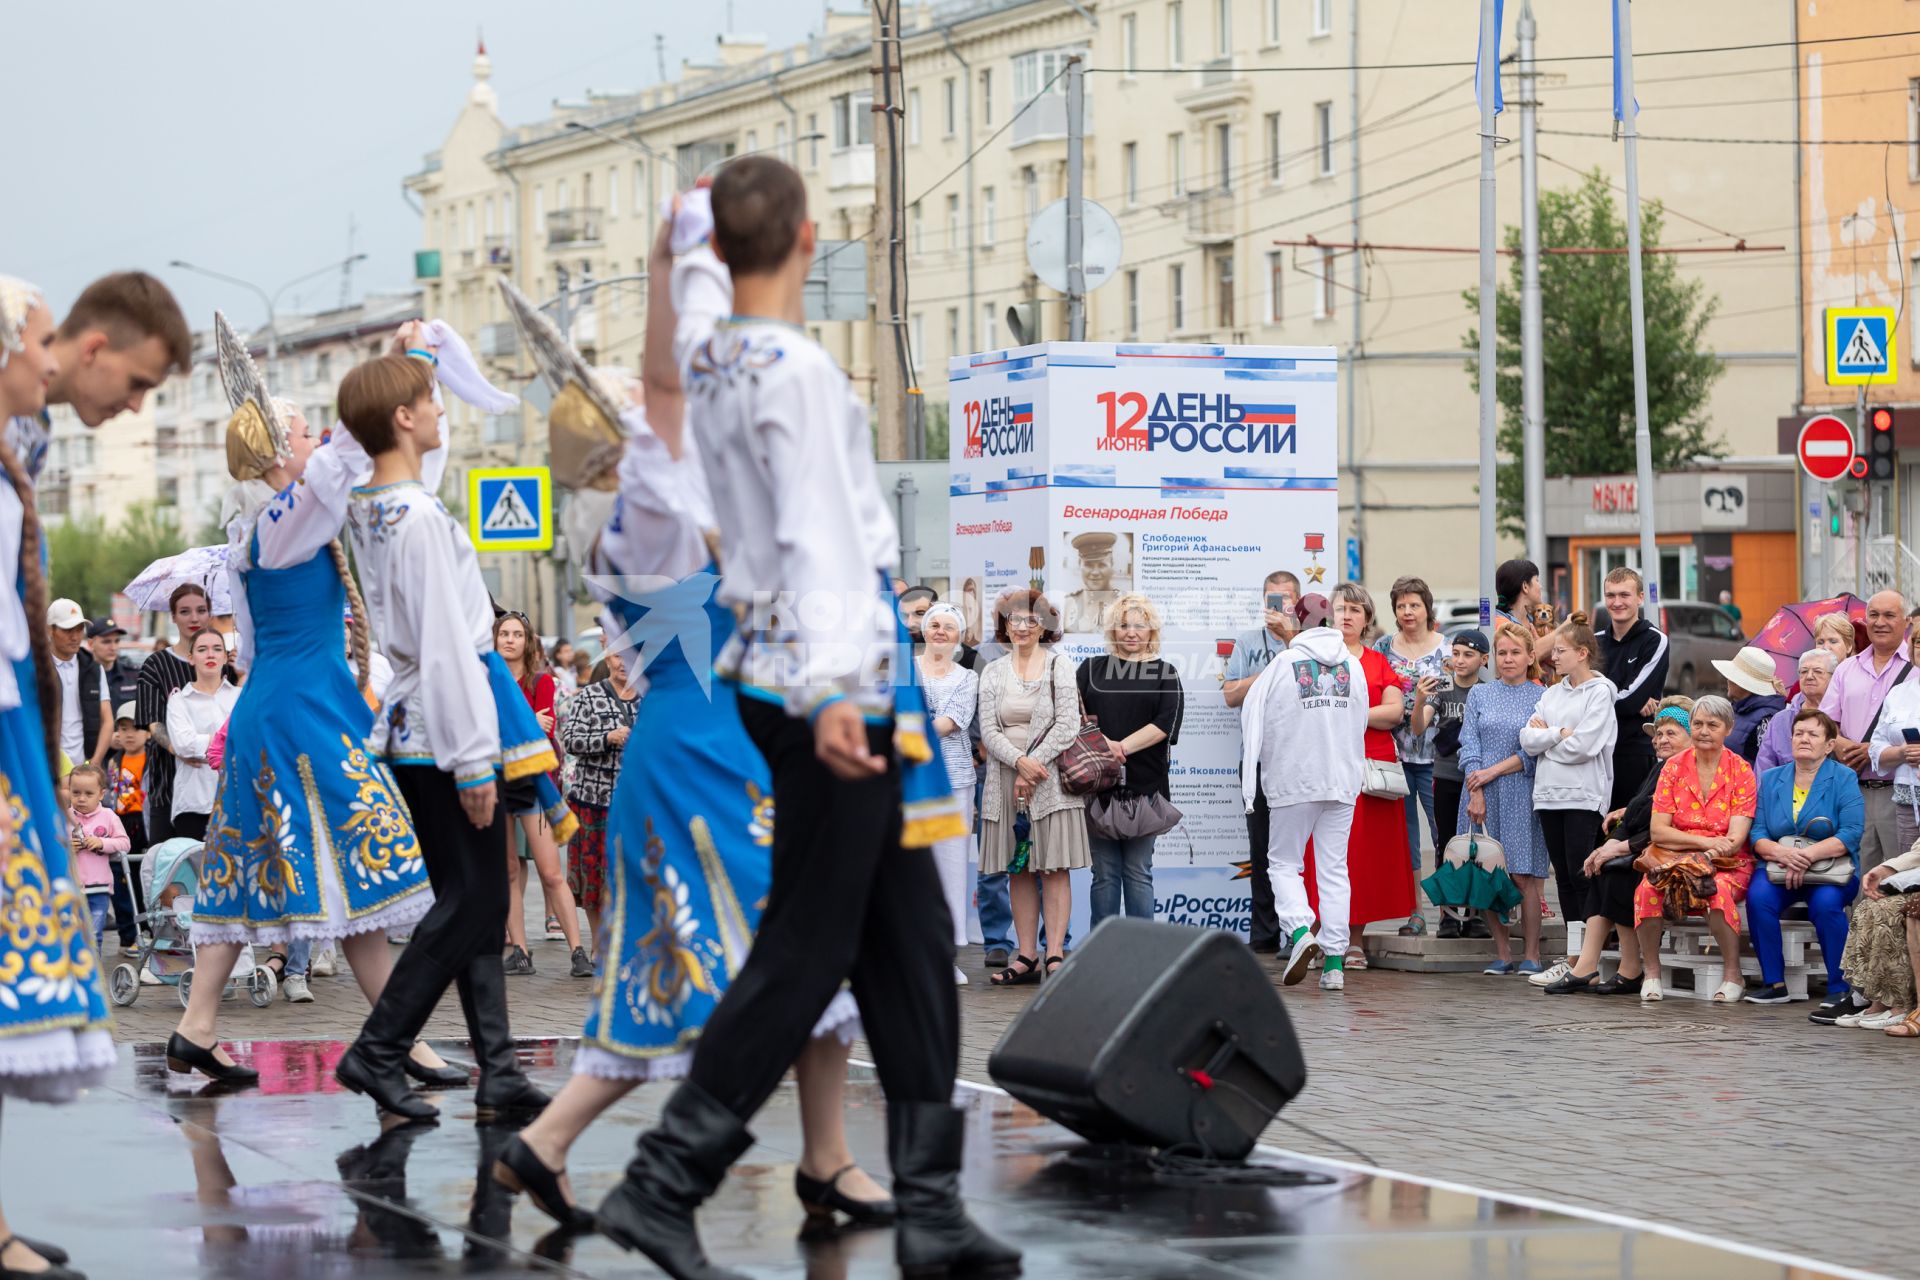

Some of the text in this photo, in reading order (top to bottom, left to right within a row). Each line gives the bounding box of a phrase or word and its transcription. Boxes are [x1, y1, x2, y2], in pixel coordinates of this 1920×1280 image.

[964, 400, 982, 446] 12
[981, 396, 1015, 428] ДЕНЬ
[1097, 391, 1148, 438] 12
[1148, 392, 1246, 423] ДЕНЬ
[981, 423, 1033, 457] РОССИИ
[1148, 422, 1296, 454] РОССИИ
[1063, 505, 1229, 522] Всенародная Победа
[1142, 533, 1207, 543] Слободенюк
[1142, 542, 1261, 553] Григорий Афанасьевич
[1153, 894, 1252, 914] ыРоссия
